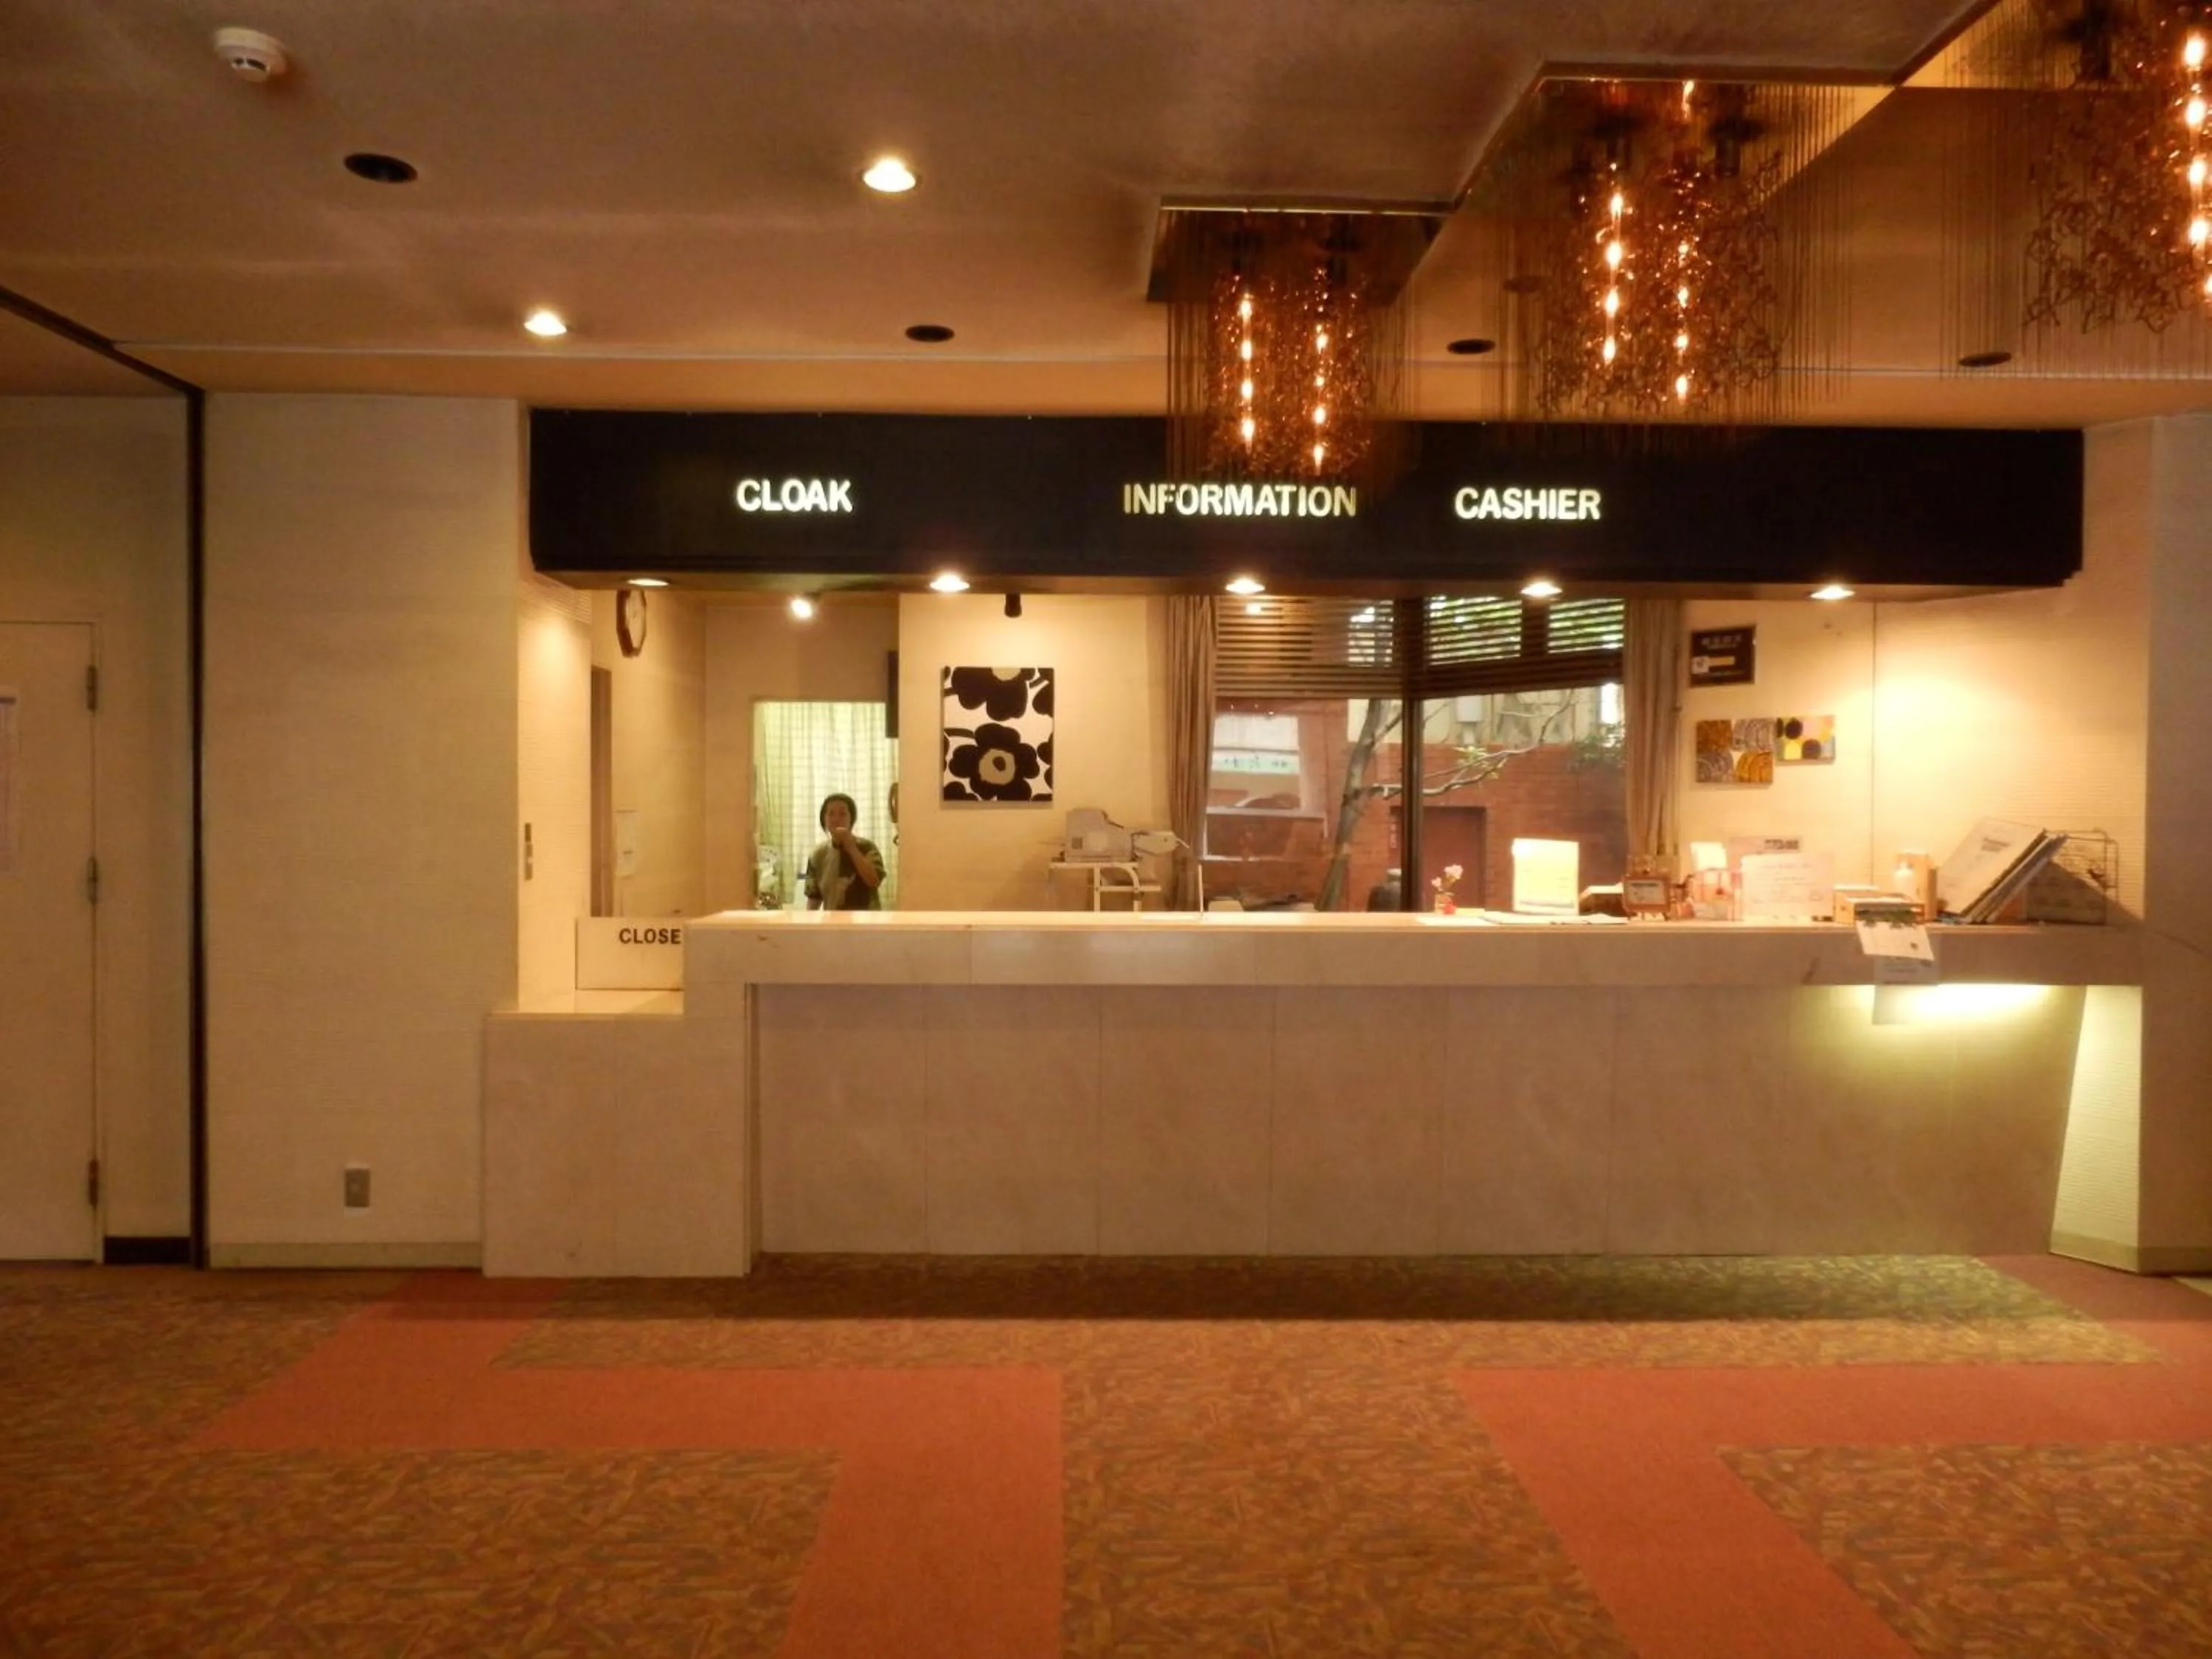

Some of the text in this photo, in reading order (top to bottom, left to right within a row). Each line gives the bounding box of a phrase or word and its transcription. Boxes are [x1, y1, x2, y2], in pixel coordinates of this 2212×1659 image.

[736, 478, 853, 512] CLOAK
[1123, 484, 1357, 517] INFORMATION
[1454, 487, 1601, 521] CASHIER
[619, 928, 681, 945] CLOSE
